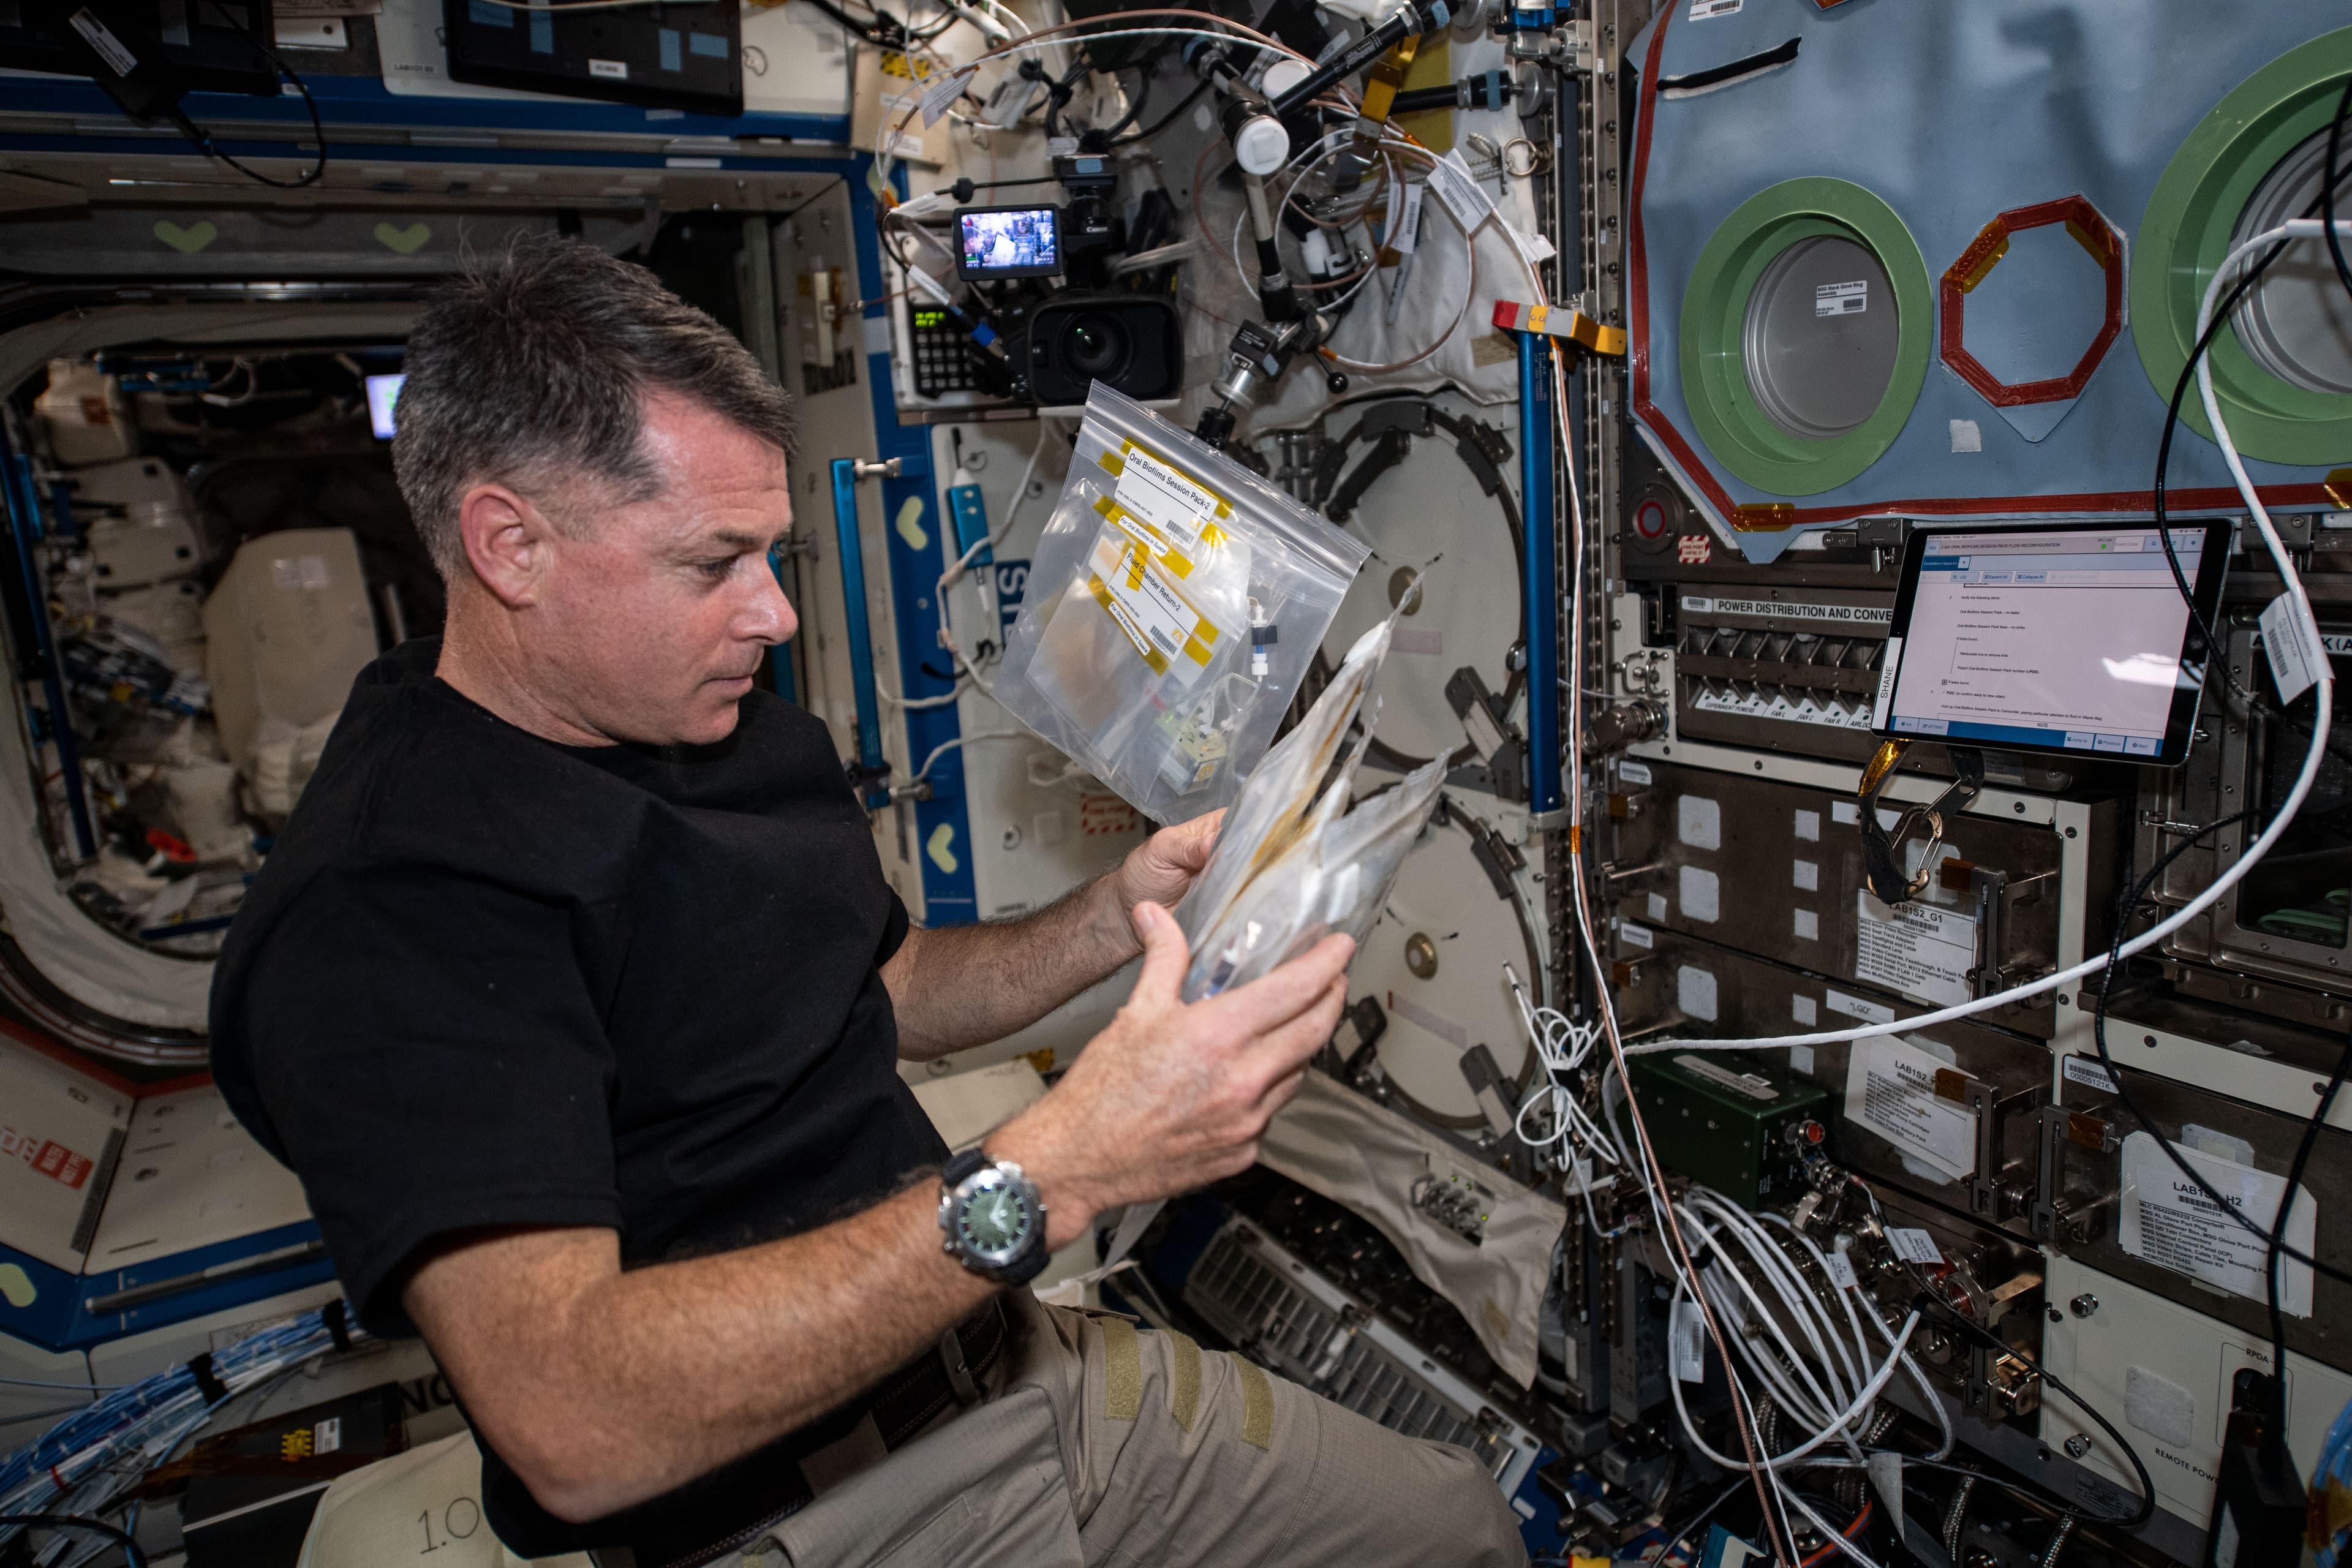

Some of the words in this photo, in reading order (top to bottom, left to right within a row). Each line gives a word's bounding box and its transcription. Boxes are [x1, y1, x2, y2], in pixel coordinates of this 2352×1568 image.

[1129, 453, 1142, 466] Oral
[1142, 461, 1166, 481] Biofilms
[1166, 477, 1189, 497] Session
[1190, 492, 1210, 510] Pack-2
[1127, 522, 1136, 532] Oral
[1135, 528, 1150, 542] Biofilms
[1154, 541, 1166, 554] Space
[1127, 552, 1139, 569] Fluid
[1139, 565, 1161, 590] Chamber
[1159, 587, 1181, 612] Return-2
[1719, 600, 1752, 612] POWER
[1755, 603, 1826, 617] DISTRIBUTION
[1828, 607, 1851, 619] AND
[1123, 616, 1136, 635] Biofilms
[1138, 638, 1148, 654] Space
[1880, 666, 1894, 699] SHANE
[1705, 703, 1733, 712] EXPERIMENT
[1872, 934, 1894, 945] Spotlights
[1884, 925, 1896, 933] Video
[1899, 929, 1917, 940] Recorder
[1896, 935, 1915, 946] Adapters
[1871, 940, 1891, 950] Standard
[1883, 962, 1896, 971] SAMS
[1872, 971, 1899, 985] Multipurpose
[1896, 973, 1921, 986] Extensions
[1921, 970, 1942, 979] Ethernet
[1942, 975, 1956, 984] Cable
[1895, 1060, 1932, 1085] LAB1S2_
[2163, 1215, 2179, 1224] Glove
[2180, 1219, 2193, 1228] Port
[2194, 1224, 2207, 1233] Plug
[2155, 1218, 2188, 1233] Conditioner
[2203, 1232, 2217, 1241] MSG
[2218, 1237, 2236, 1246] Glove
[2237, 1242, 2251, 1251] Port
[2166, 1227, 2177, 1236] Test
[2179, 1232, 2212, 1246] Connectors
[2155, 1231, 2177, 1242] Internal
[2177, 1237, 2199, 1249] Control
[2200, 1244, 2217, 1253] Panel
[2218, 1250, 2233, 1259] (ICP)
[2157, 1243, 2173, 1253] Video
[2174, 1249, 2194, 1259] Drawer
[2195, 1256, 2214, 1266] Repair
[2156, 1237, 2174, 1247] Velcro
[2195, 1249, 2212, 1259] Cable
[2228, 1259, 2257, 1273] Mounting
[2175, 1262, 2197, 1273] Scraper
[2246, 1348, 2269, 1364] RPDA
[2155, 1447, 2190, 1471] REMOTE
[2193, 1466, 2219, 1485] POWE
